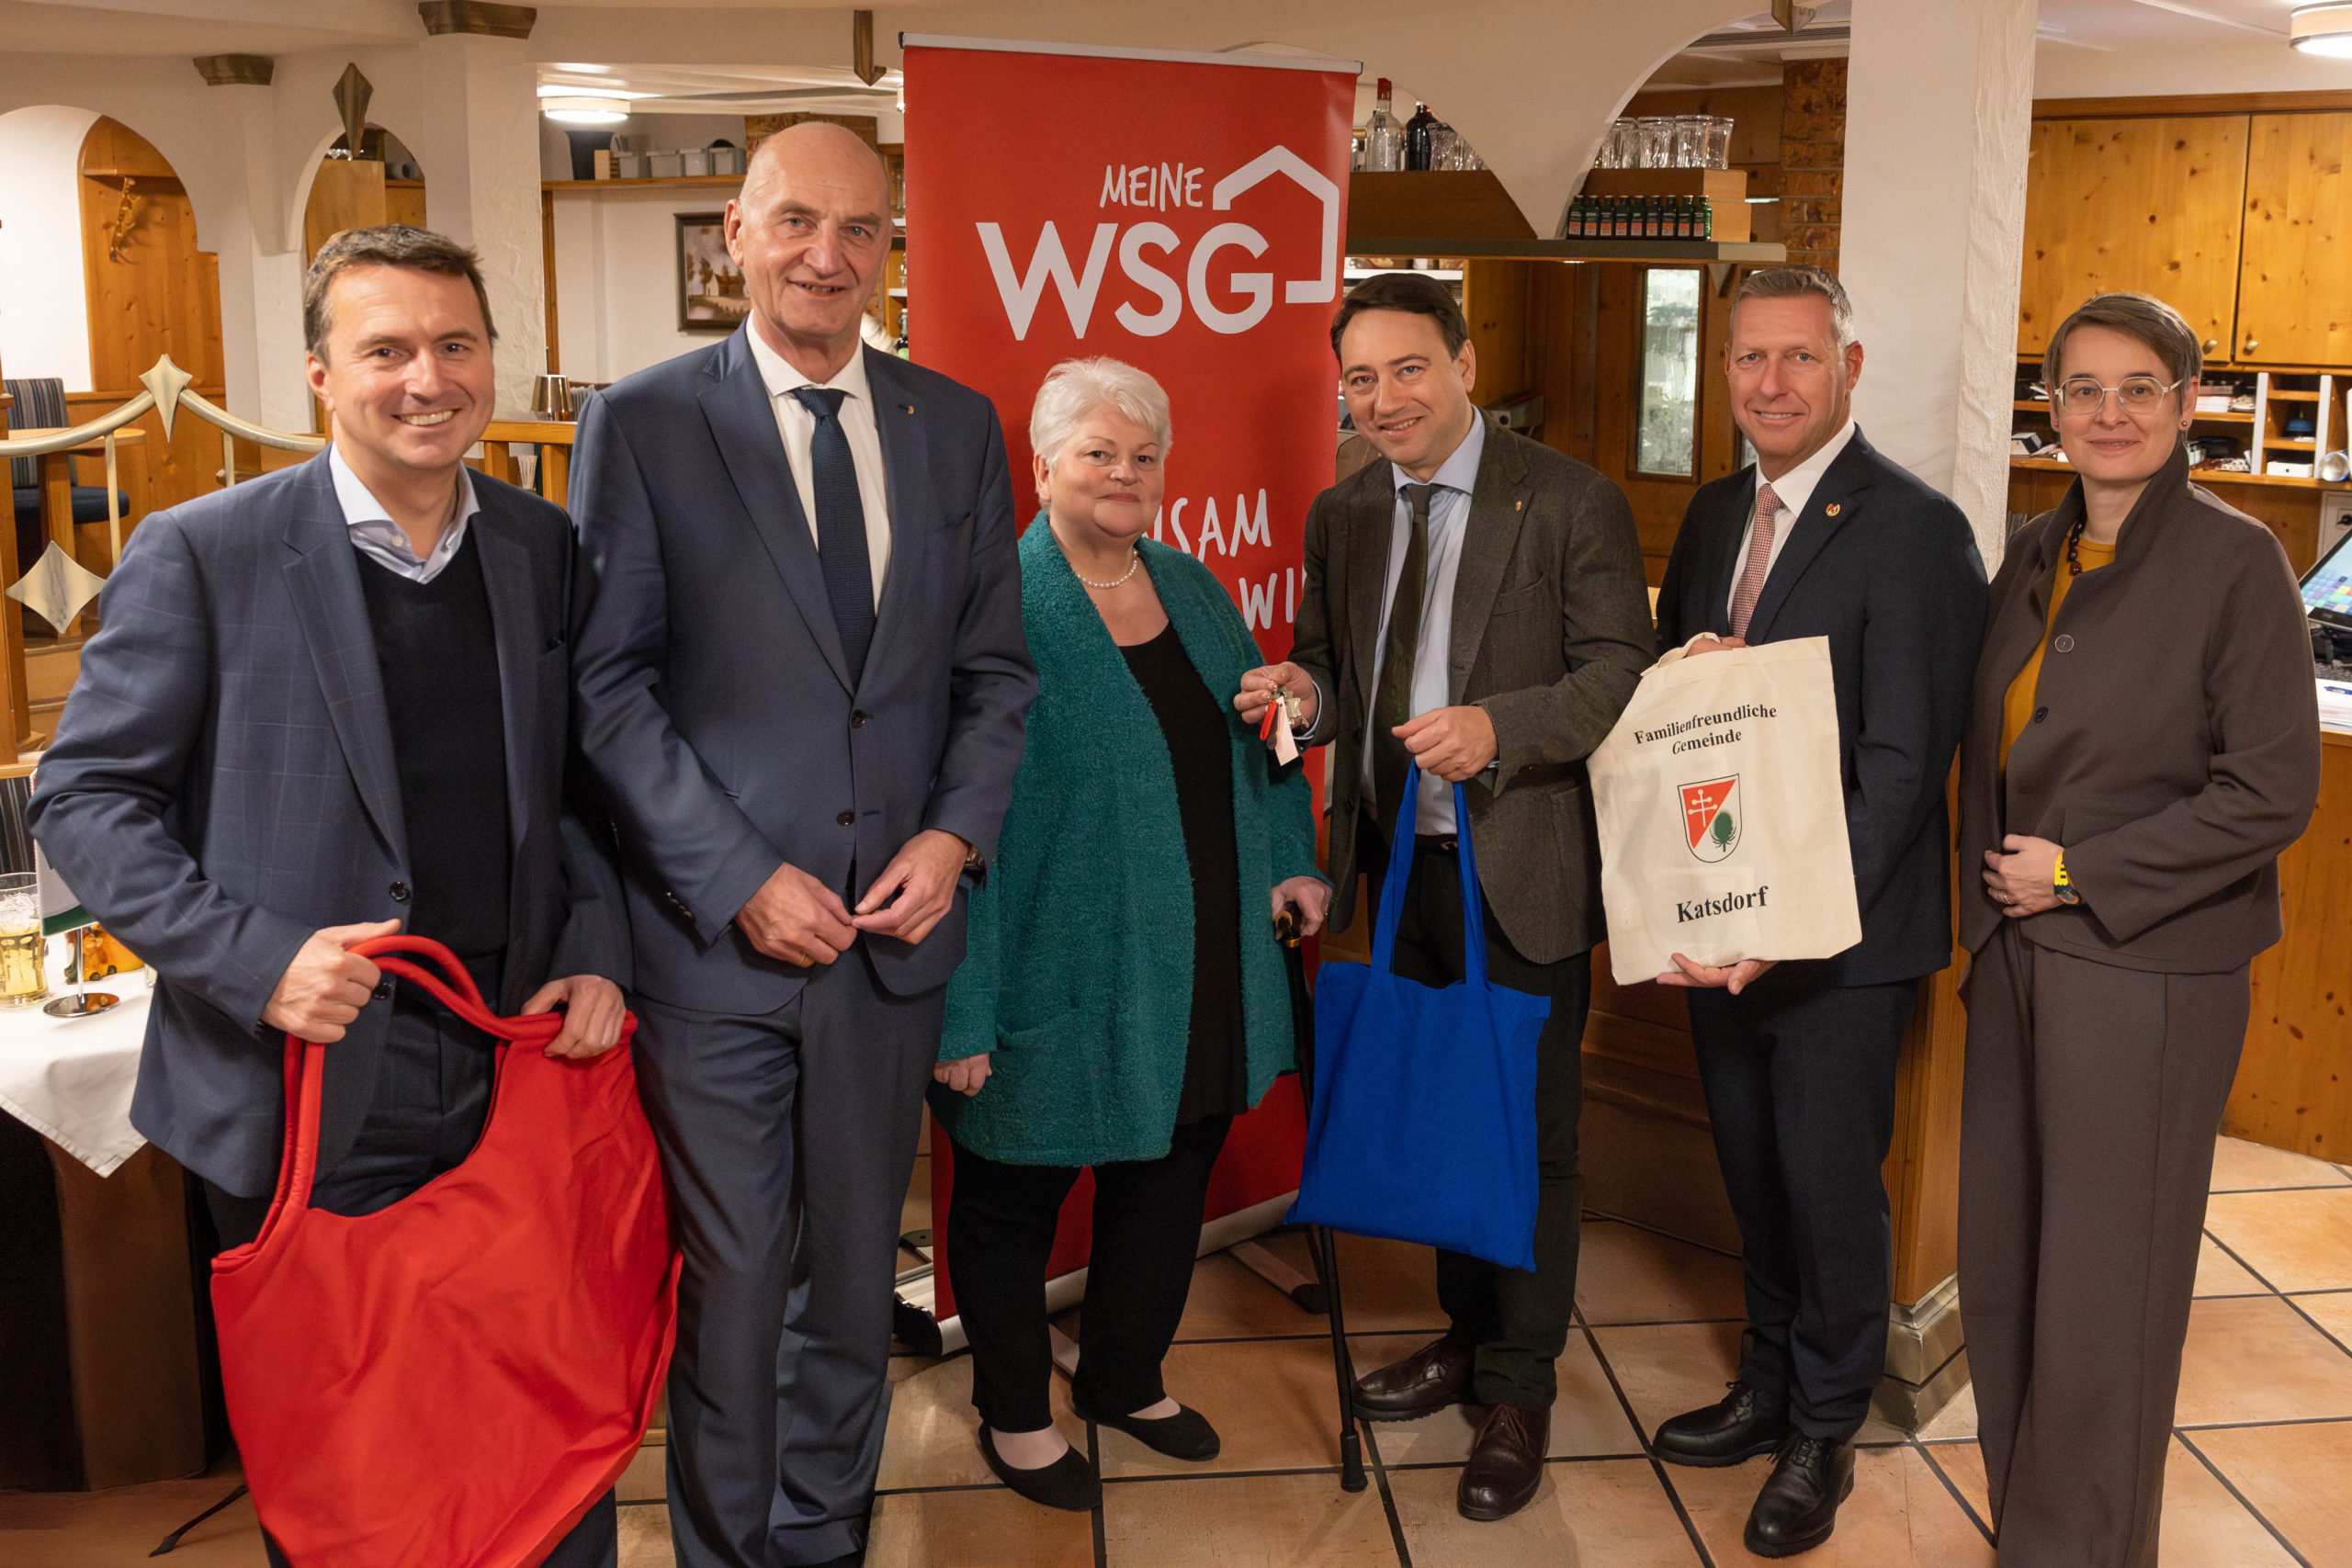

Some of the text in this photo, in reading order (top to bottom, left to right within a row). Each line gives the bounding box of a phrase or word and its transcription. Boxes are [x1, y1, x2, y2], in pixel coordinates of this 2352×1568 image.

[1099, 162, 1204, 212] MEINE
[975, 220, 1274, 342] WSG
[1238, 567, 1308, 632] WI
[1634, 704, 1778, 745] Familienfreundliche
[1671, 728, 1743, 756] Gemeinde
[1676, 886, 1770, 924] Katsdorf
